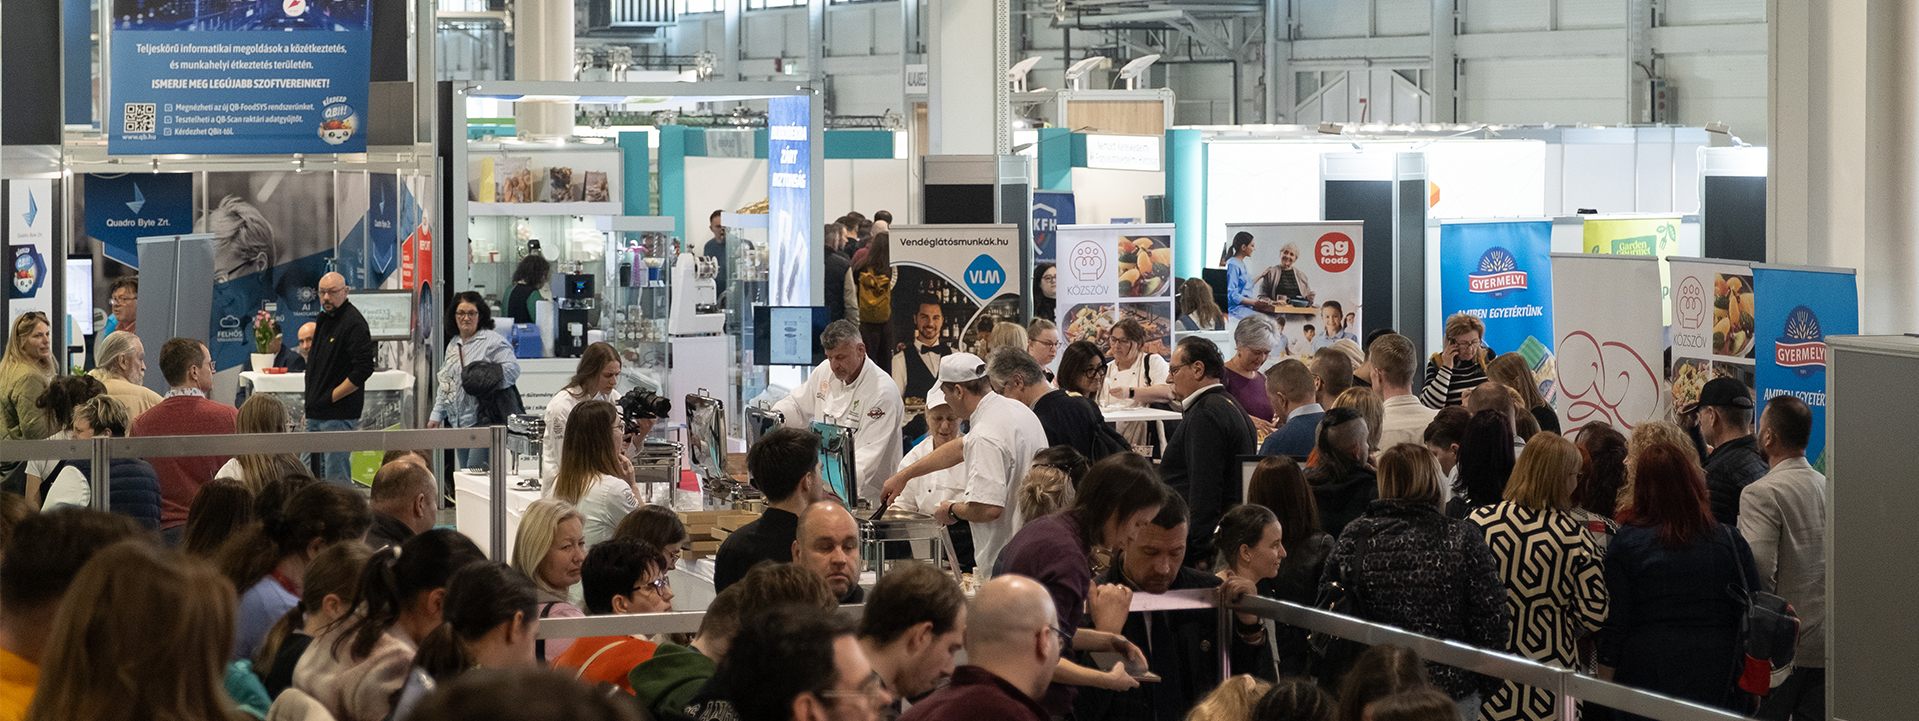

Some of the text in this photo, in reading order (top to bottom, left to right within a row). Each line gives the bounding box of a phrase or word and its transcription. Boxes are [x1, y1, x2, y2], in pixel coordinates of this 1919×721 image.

[136, 43, 179, 55] Teljeskörű
[180, 44, 232, 54] informatikai
[233, 43, 283, 55] megoldások
[290, 43, 347, 54] közétkeztetés,
[170, 60, 314, 71] és munkahelyi étkeztetés területén.
[152, 76, 330, 89] ISMERJE MEG LEGÚJABB SZOFTVEREINKET!
[176, 103, 213, 112] Megnézheti
[222, 103, 229, 112] új
[229, 103, 267, 112] QB-FoodSYS
[268, 103, 315, 111] rendszerünket.
[325, 106, 347, 118] QBit!
[175, 115, 210, 123] Tesztelheti
[174, 127, 207, 135] Kérdezhet
[780, 145, 798, 164] ZÁRT
[106, 218, 170, 228] Quadro Byte Zrt.
[1033, 218, 1057, 231] KFH
[900, 238, 1009, 248] Vendéglátósmunkák.hu
[1320, 241, 1349, 256] ag
[1619, 240, 1647, 250] Garden
[969, 269, 1000, 284] VLM
[1471, 274, 1524, 289] GYERMELYI
[1067, 284, 1109, 295] KÖZSZÖV
[1489, 304, 1543, 318] EGYETÉRTÜNK
[1673, 333, 1707, 348] KÖZSZÖV
[1795, 390, 1826, 406] EGYETÉR
